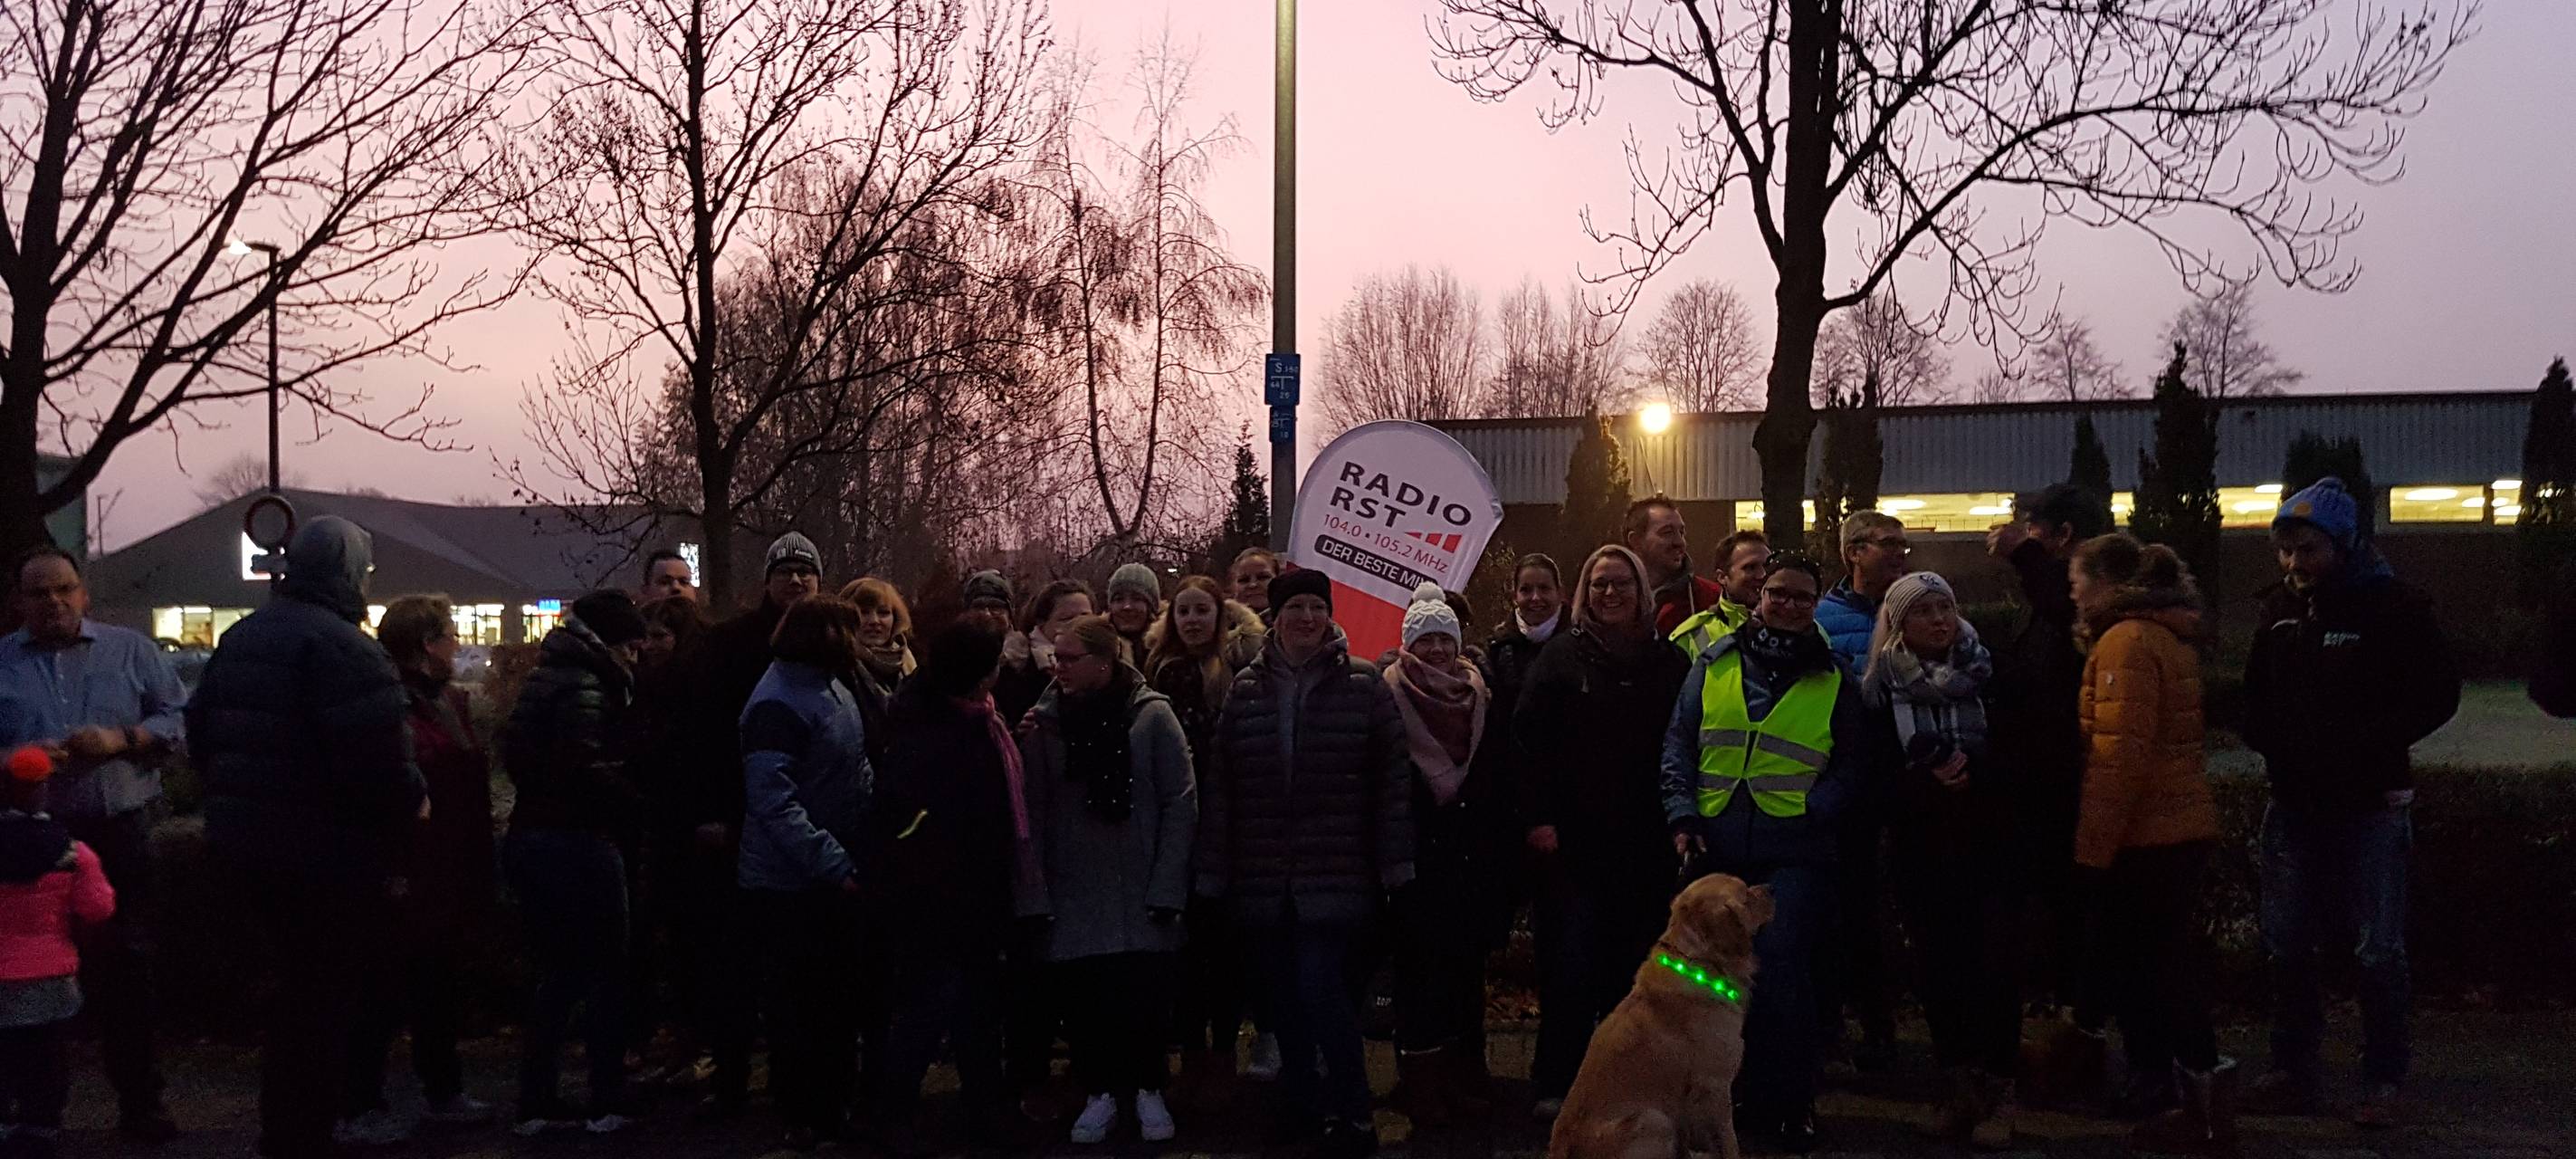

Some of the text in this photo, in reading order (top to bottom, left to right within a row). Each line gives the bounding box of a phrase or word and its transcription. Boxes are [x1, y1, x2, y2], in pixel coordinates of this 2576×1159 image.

[1274, 362, 1283, 373] S
[1329, 486, 1407, 529] RST
[1339, 461, 1473, 527] RADIO
[1321, 539, 1425, 589] DER BESTE MI
[1323, 513, 1449, 574] 104.0 105.2 MHz
